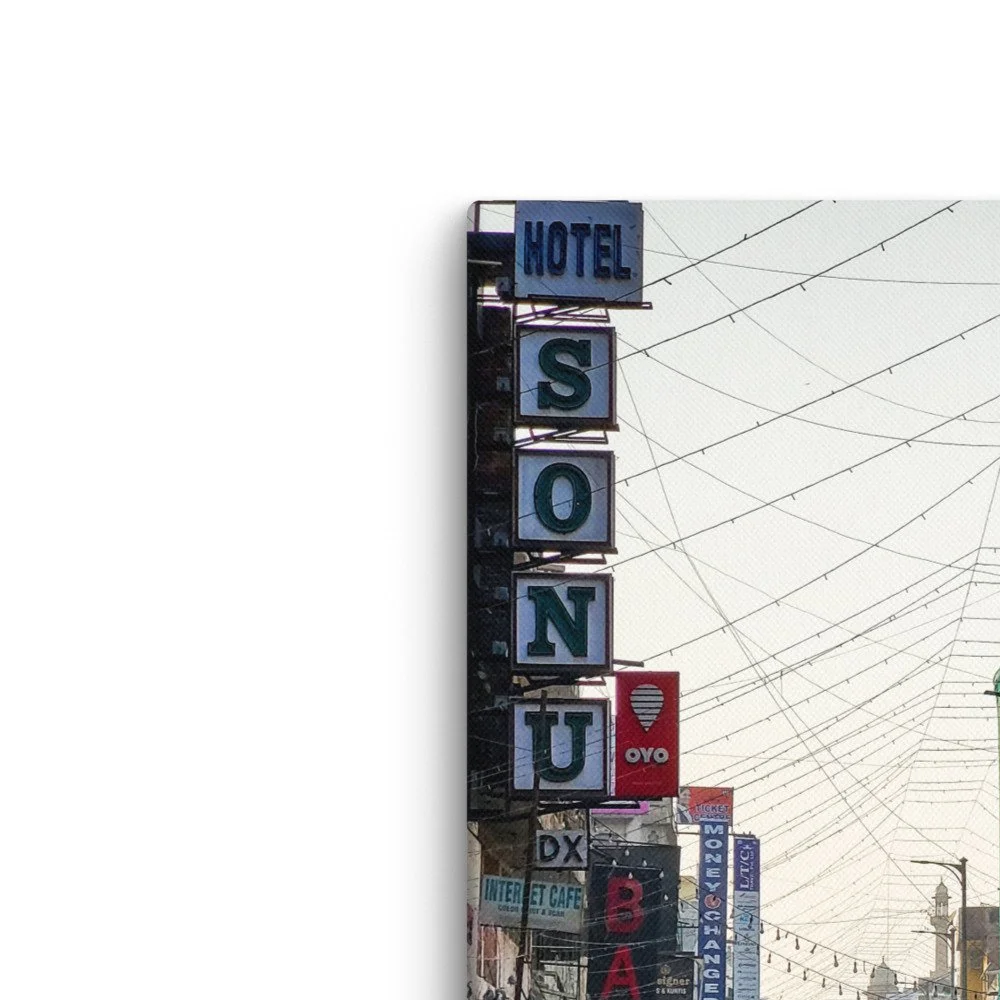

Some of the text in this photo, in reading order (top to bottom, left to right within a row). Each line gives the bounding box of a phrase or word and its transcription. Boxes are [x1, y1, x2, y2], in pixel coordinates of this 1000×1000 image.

[523, 220, 632, 280] HOTEL
[625, 747, 669, 764] OYO
[695, 804, 729, 813] TICKET
[539, 834, 585, 863] DX
[703, 824, 724, 892] MONEY
[484, 878, 582, 910] INTERET CAFE
